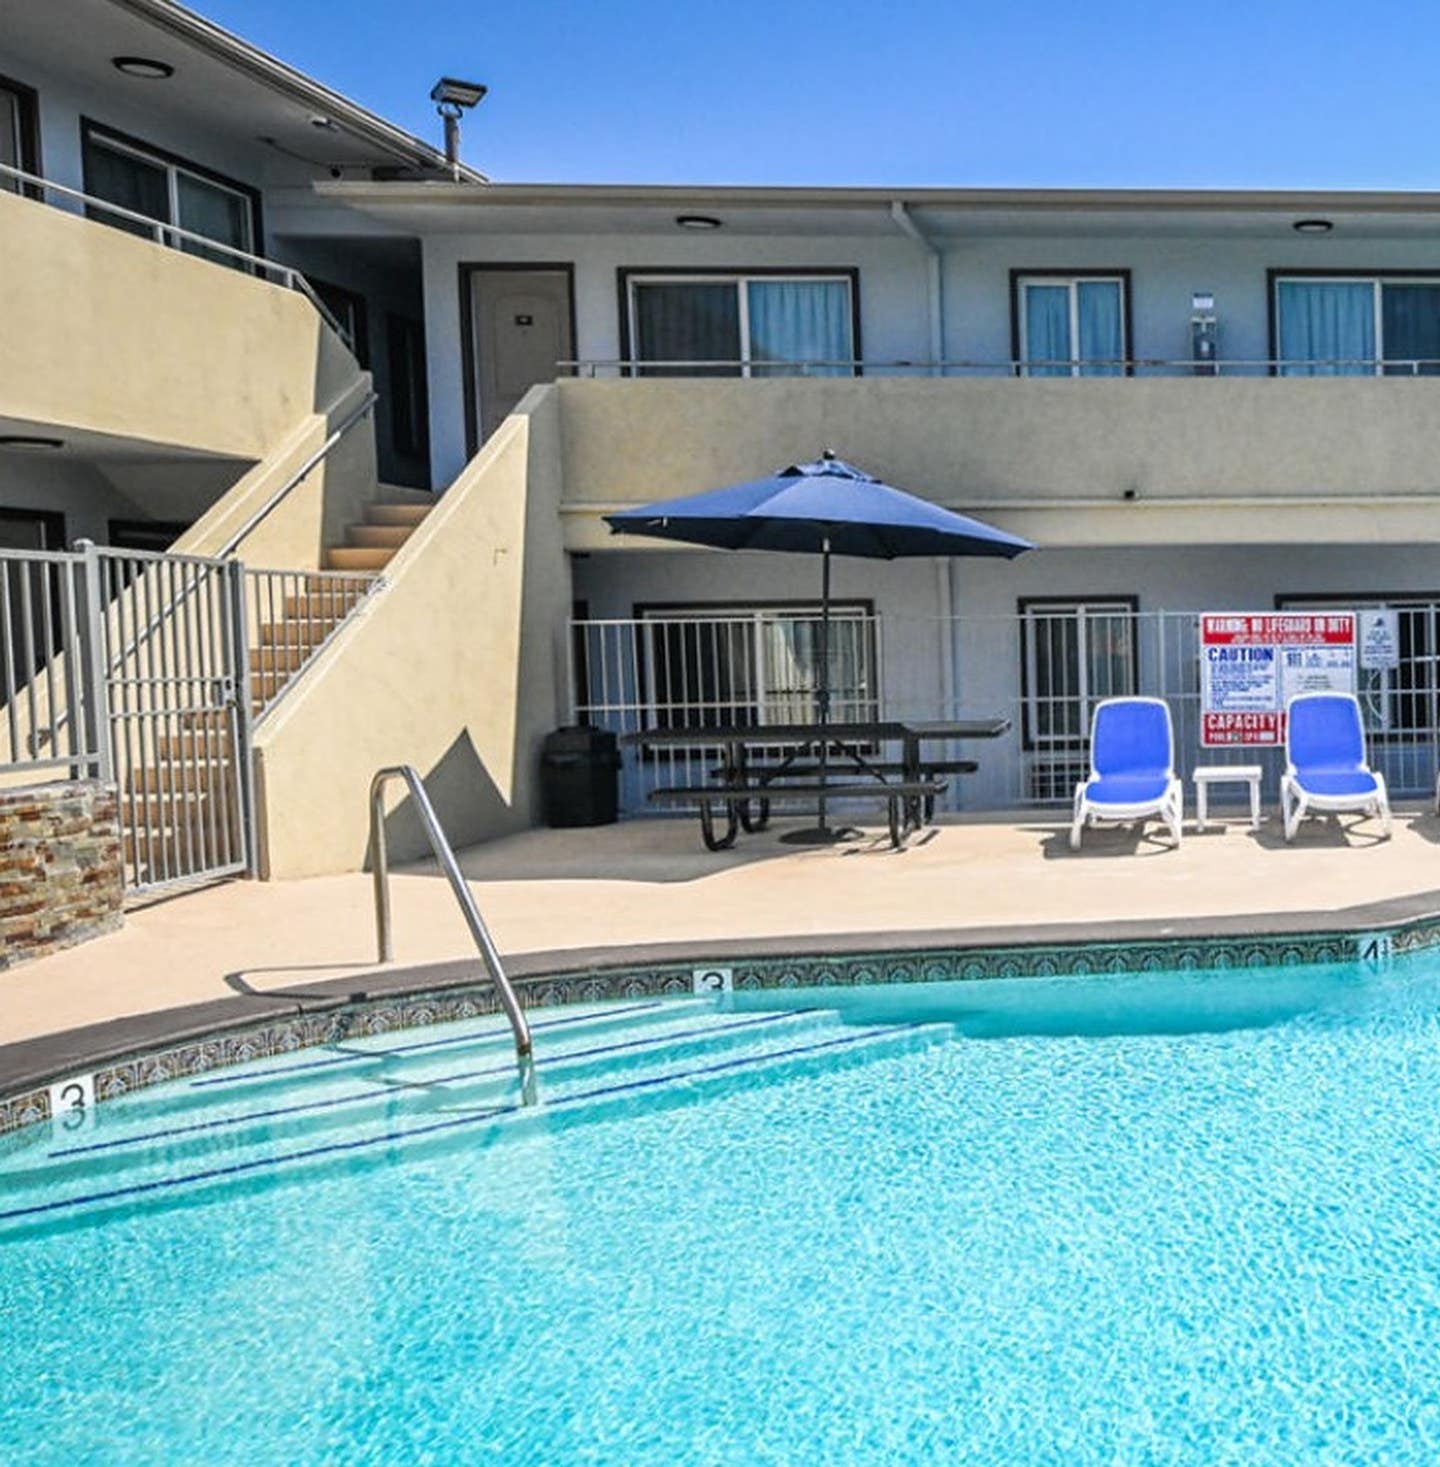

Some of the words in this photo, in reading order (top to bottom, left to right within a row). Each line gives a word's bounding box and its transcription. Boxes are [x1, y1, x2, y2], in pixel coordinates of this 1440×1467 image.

[1327, 617, 1350, 633] DUTY
[1208, 647, 1273, 661] CAUTION
[1208, 714, 1275, 729] CAPACITY
[61, 1083, 85, 1130] 3
